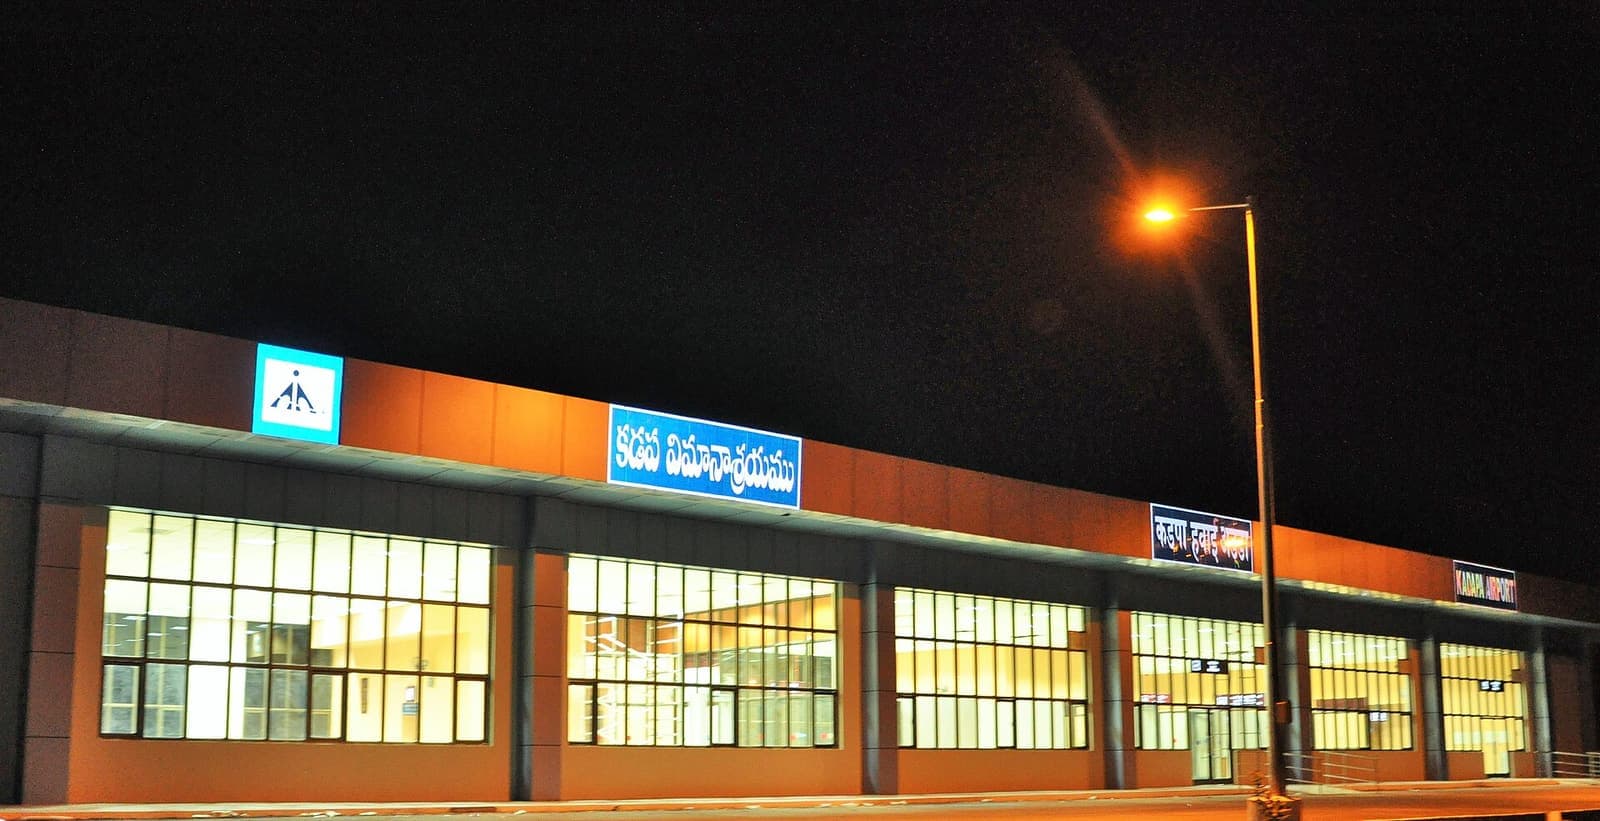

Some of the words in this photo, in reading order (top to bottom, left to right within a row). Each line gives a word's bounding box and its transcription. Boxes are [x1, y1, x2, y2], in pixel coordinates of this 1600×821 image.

[616, 424, 660, 472] కడప
[666, 433, 794, 494] విమానాశ్రయము
[1455, 569, 1485, 599] KADAPA
[1485, 575, 1514, 603] AIRPORT
